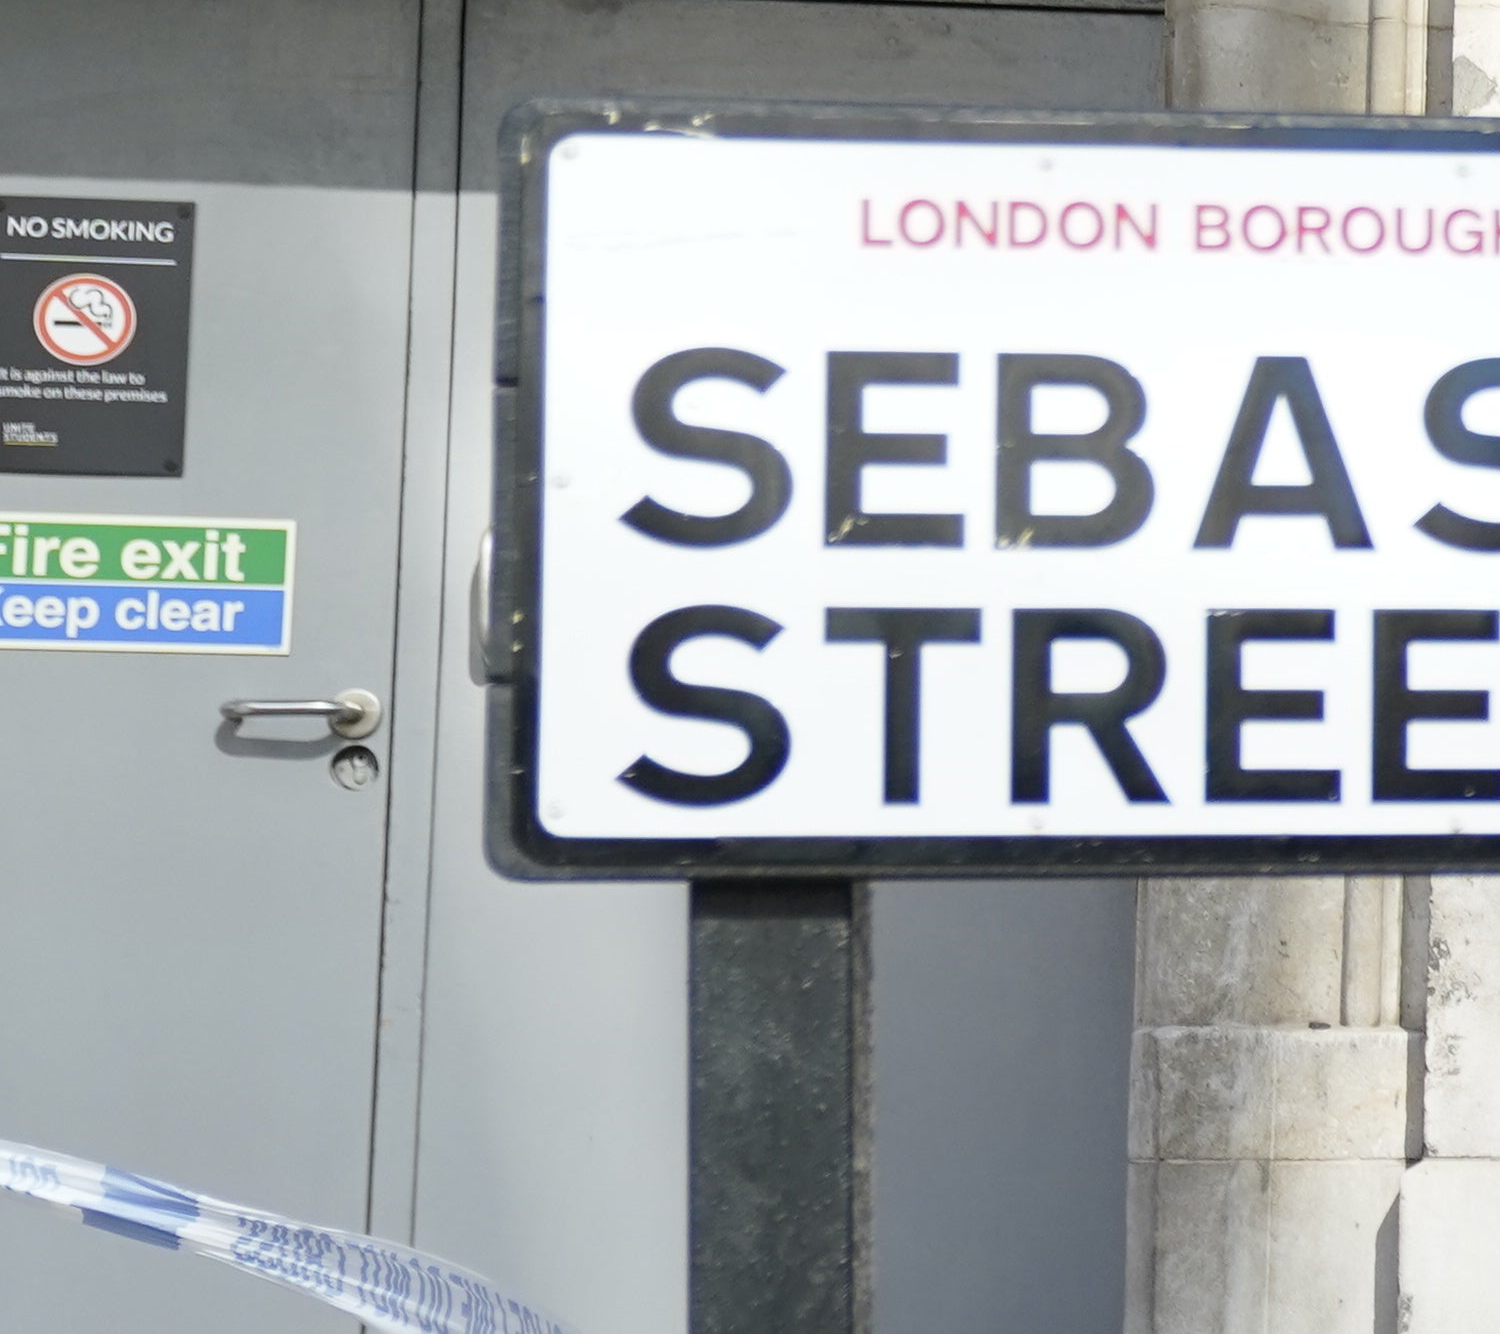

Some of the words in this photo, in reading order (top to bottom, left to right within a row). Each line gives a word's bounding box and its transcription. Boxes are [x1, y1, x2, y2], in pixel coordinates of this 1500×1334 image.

[6, 216, 48, 238] NO
[51, 218, 175, 243] SMOKING
[859, 198, 1159, 252] LONDON
[24, 369, 75, 384] against
[76, 369, 100, 384] the
[102, 370, 127, 384] law
[129, 371, 146, 385] to
[43, 387, 62, 399] on
[64, 386, 103, 401] these
[104, 388, 168, 403] premises
[120, 529, 247, 582] exit
[114, 589, 245, 632] clear
